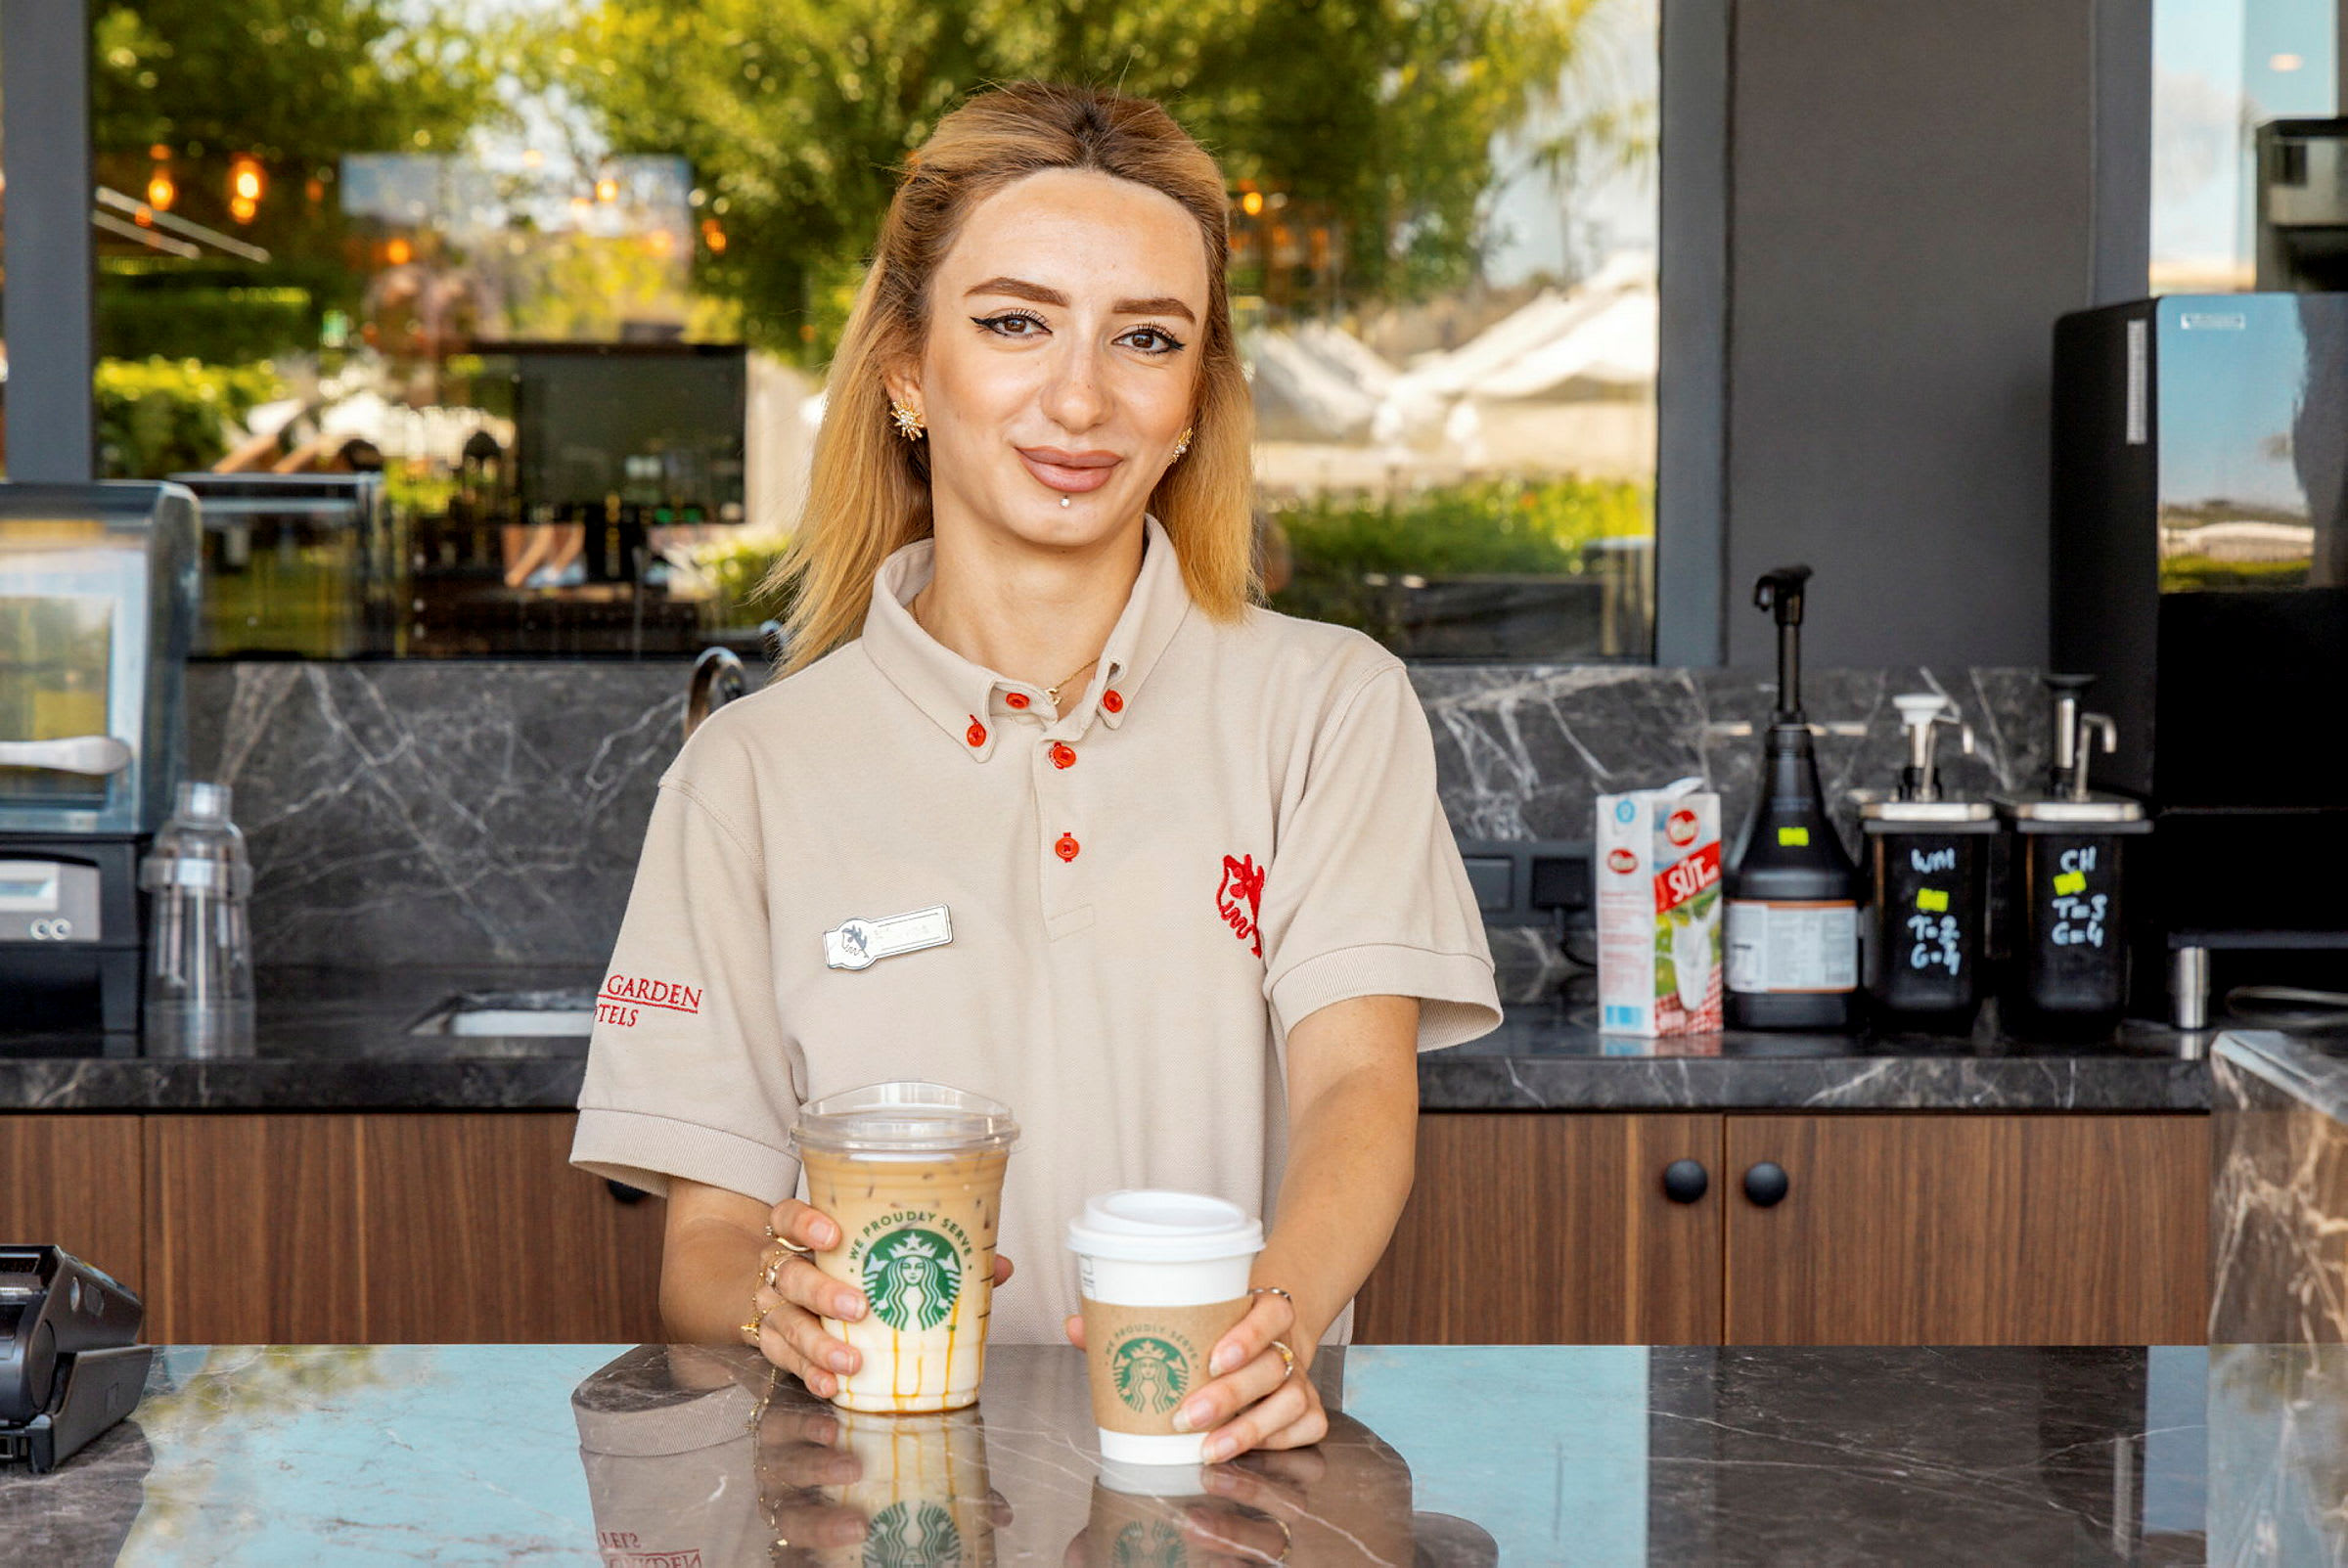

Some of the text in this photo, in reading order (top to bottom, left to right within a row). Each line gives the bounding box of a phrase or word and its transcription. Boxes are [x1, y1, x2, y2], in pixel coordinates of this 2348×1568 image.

[2059, 845, 2098, 873] CH
[1667, 855, 1706, 903] SÜT
[607, 974, 703, 1008] GARDEN
[594, 1004, 640, 1027] TELS
[849, 1210, 973, 1260] WE PROUDLY SERVE
[1115, 1323, 1166, 1340] PROUDLY
[1171, 1330, 1198, 1361] SERVE
